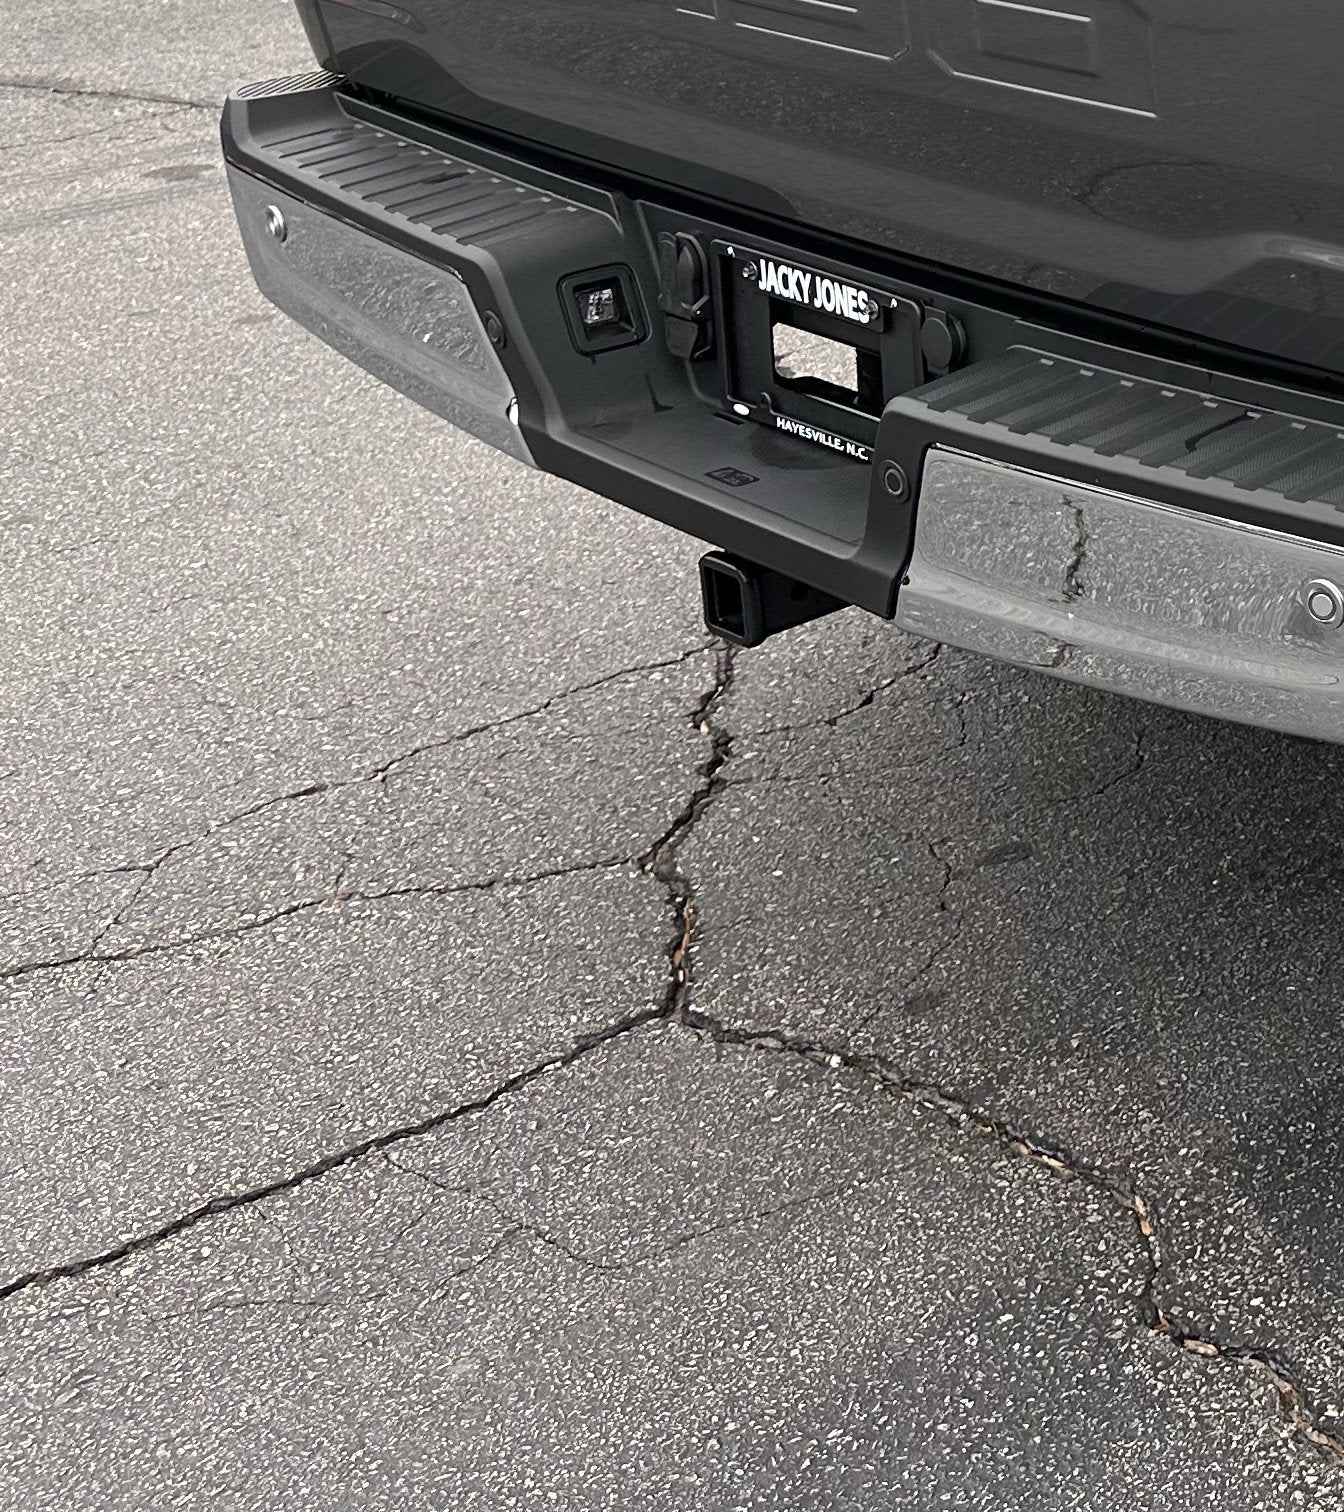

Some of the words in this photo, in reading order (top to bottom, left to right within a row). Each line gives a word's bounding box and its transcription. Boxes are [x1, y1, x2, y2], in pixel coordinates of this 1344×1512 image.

[758, 258, 812, 304] JACKY
[813, 275, 870, 324] JONES
[846, 441, 869, 461] N.C.
